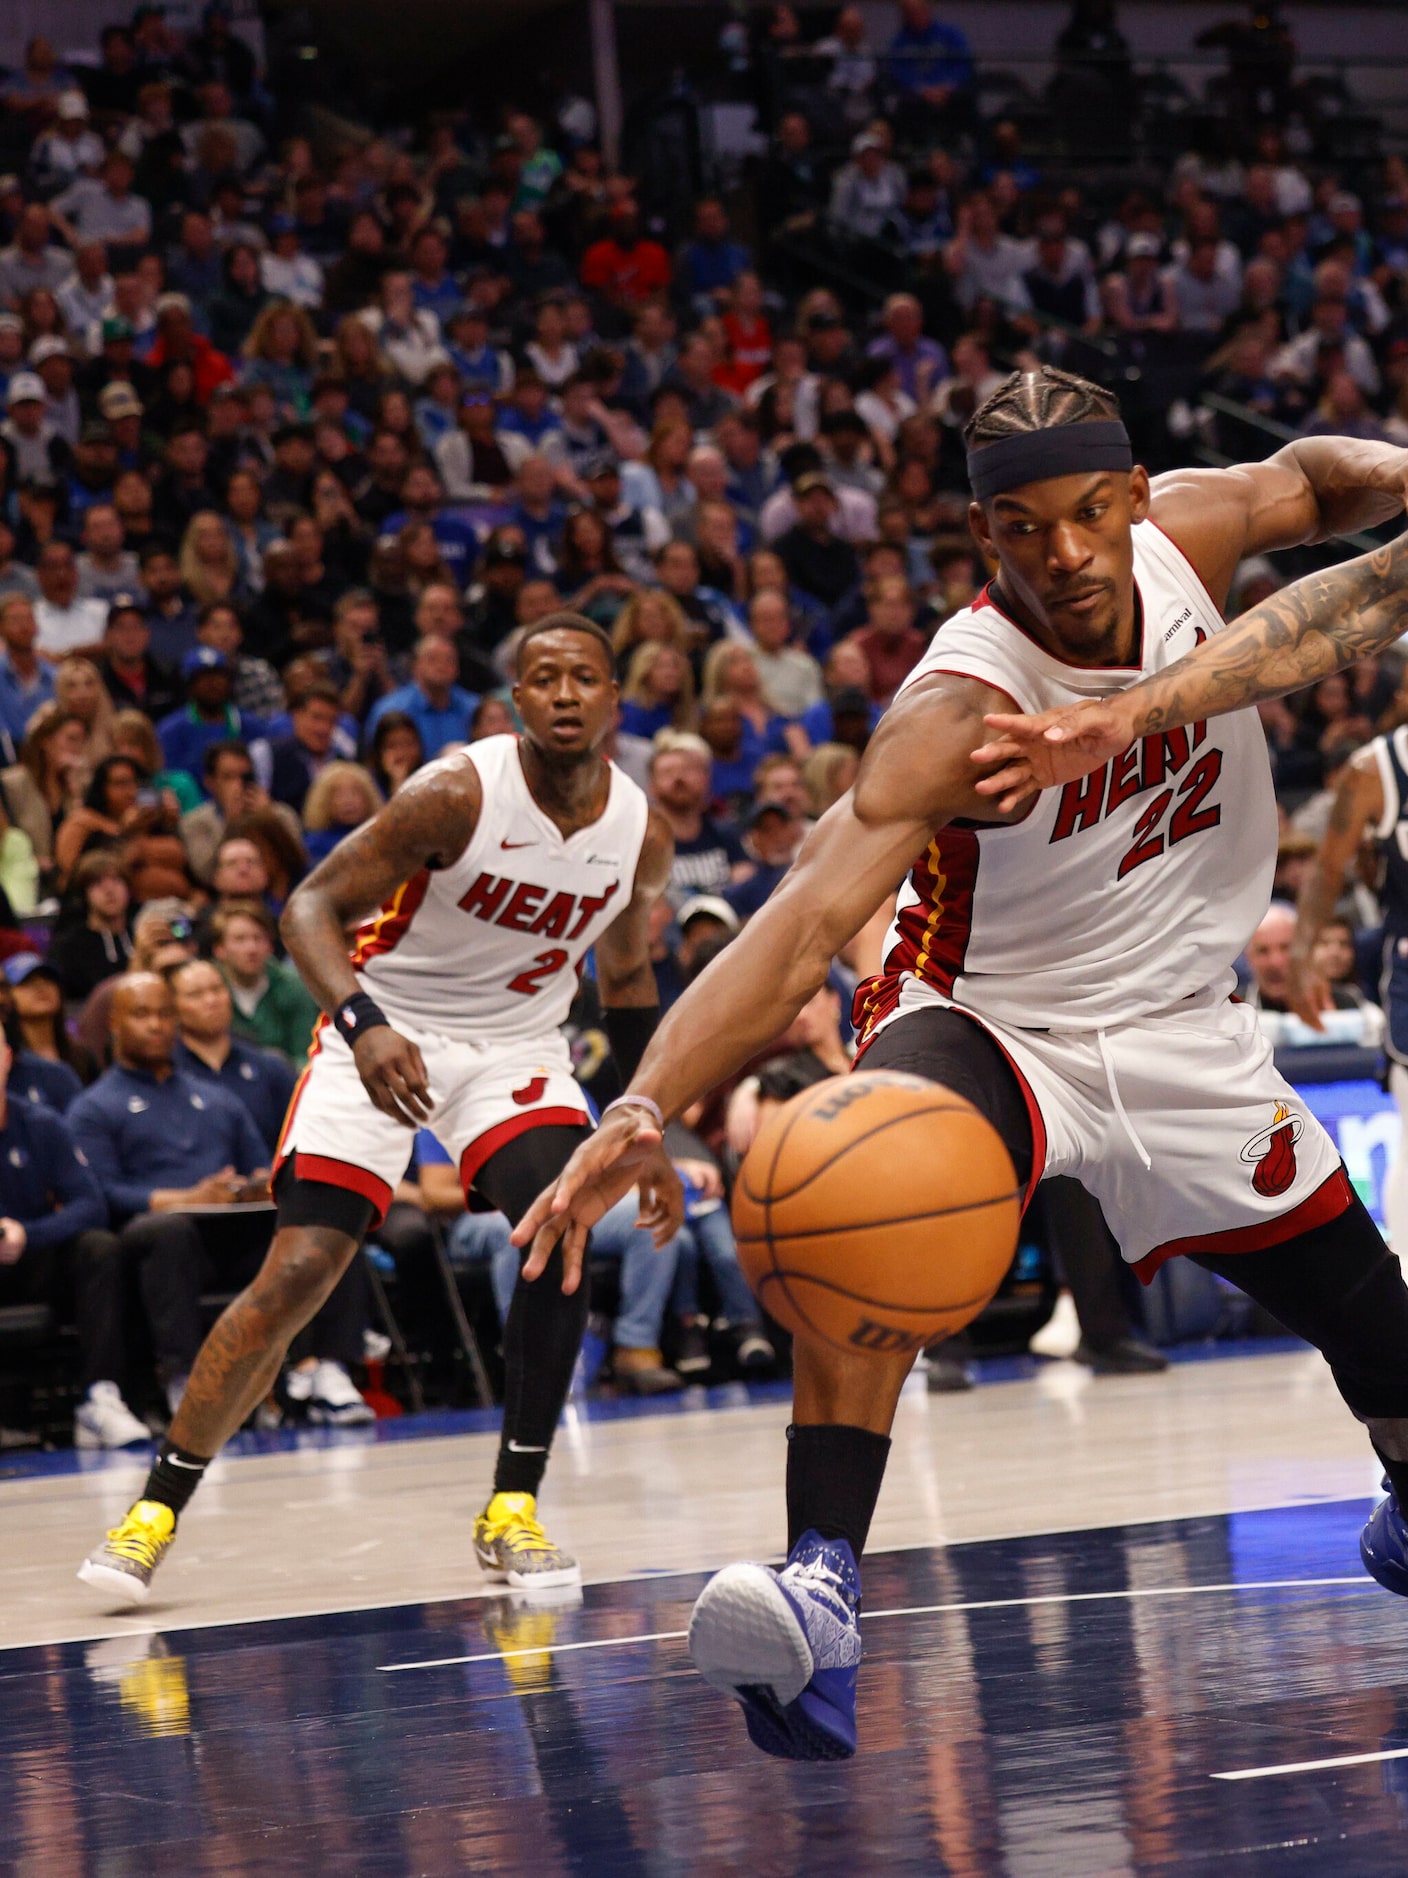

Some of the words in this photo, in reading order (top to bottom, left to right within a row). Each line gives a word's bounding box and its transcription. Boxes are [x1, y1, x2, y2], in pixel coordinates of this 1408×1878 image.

[1163, 607, 1194, 642] arnival
[1117, 747, 1224, 882] 22
[457, 872, 620, 941] HEAT
[506, 948, 569, 996] 2
